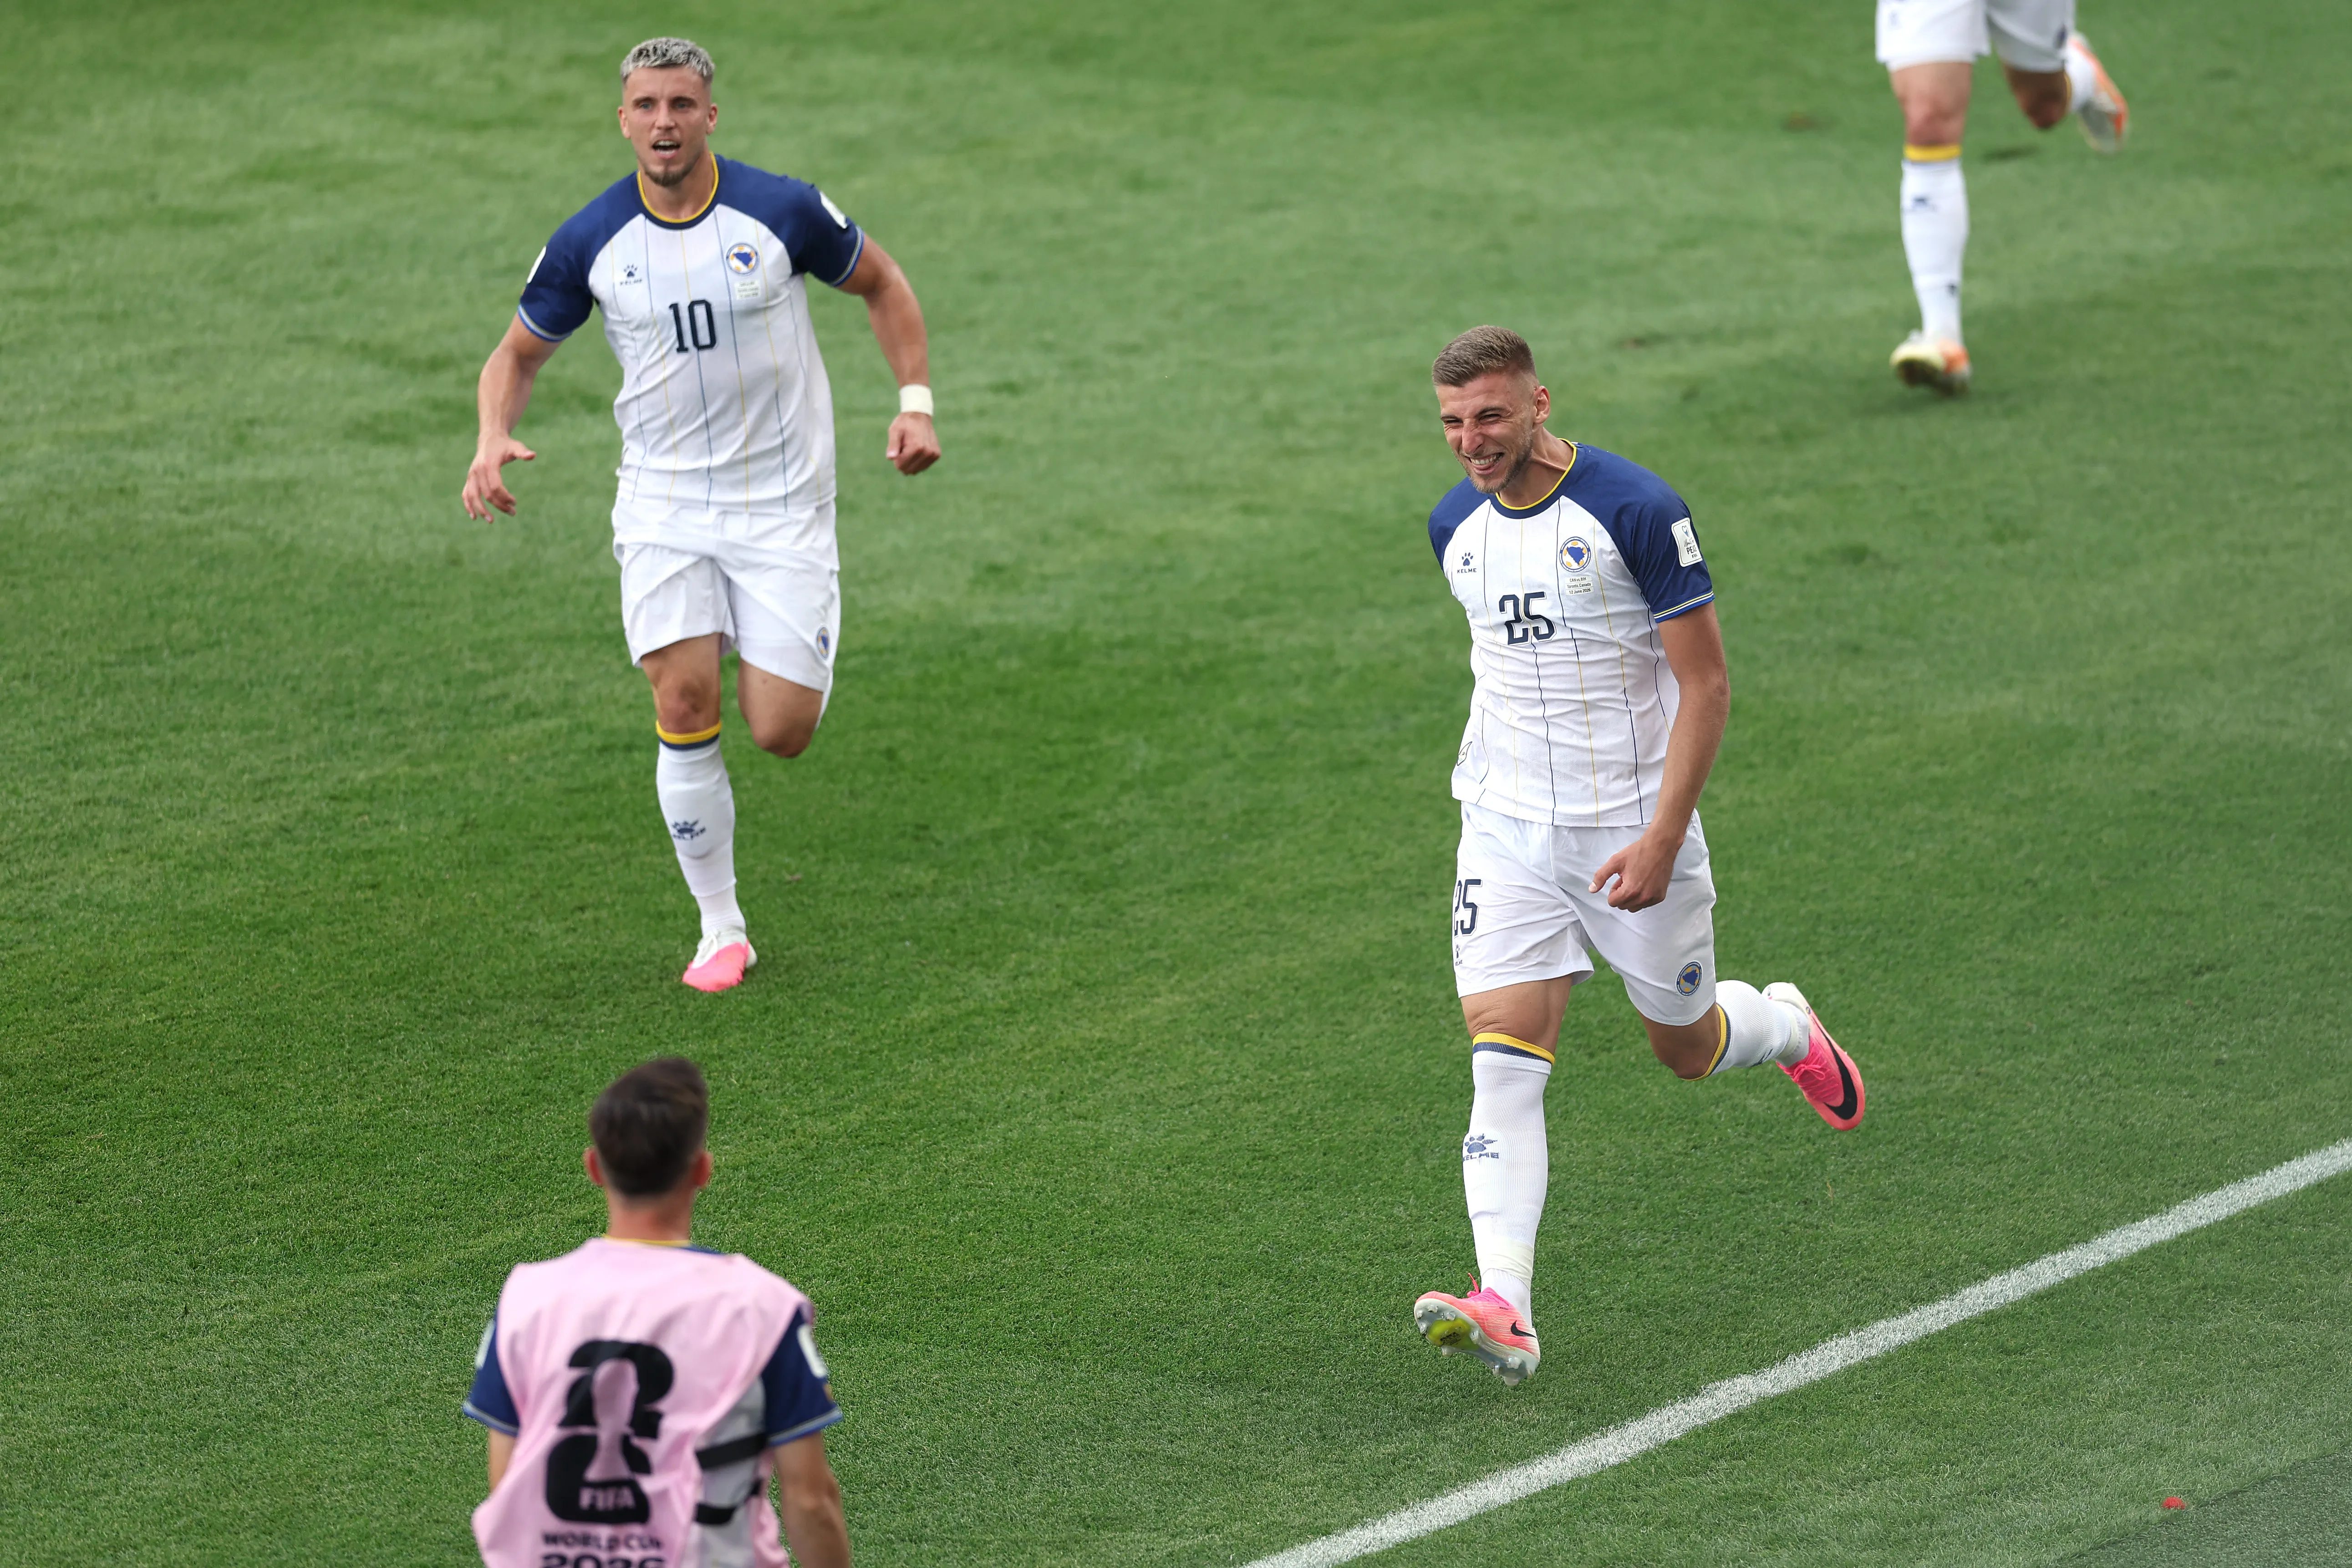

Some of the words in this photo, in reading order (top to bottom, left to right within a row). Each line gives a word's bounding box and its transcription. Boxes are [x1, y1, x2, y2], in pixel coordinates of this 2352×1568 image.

[669, 299, 717, 353] 10
[1499, 591, 1557, 646] 25
[579, 1486, 636, 1510] FIFA
